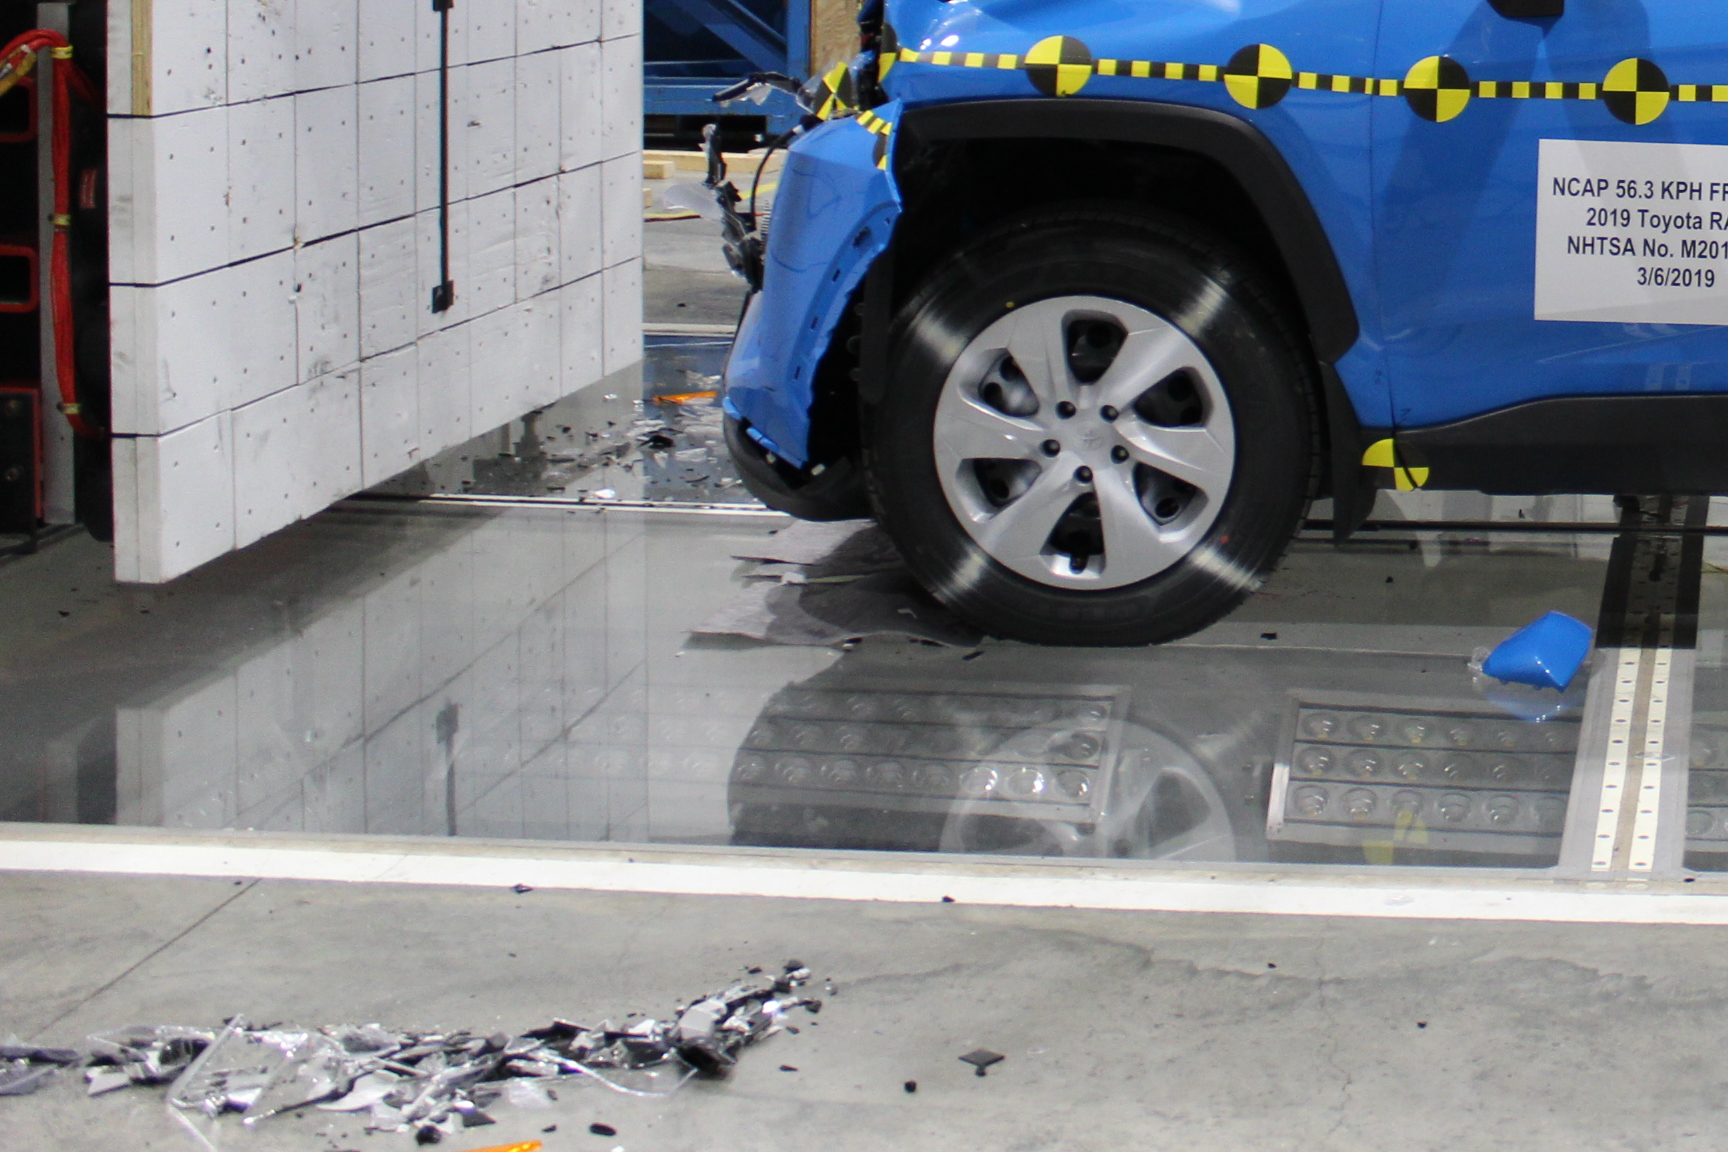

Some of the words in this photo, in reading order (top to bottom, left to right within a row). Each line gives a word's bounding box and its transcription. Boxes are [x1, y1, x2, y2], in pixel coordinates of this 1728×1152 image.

[1553, 178, 1609, 197] NCAP
[1616, 180, 1653, 199] 56.3
[1661, 181, 1702, 200] KPH
[1587, 208, 1630, 227] 2019
[1637, 209, 1702, 233] Toyota
[1568, 236, 1635, 256] NHTSA
[1643, 239, 1673, 257] No.
[1638, 267, 1714, 287] 3/6/2019
